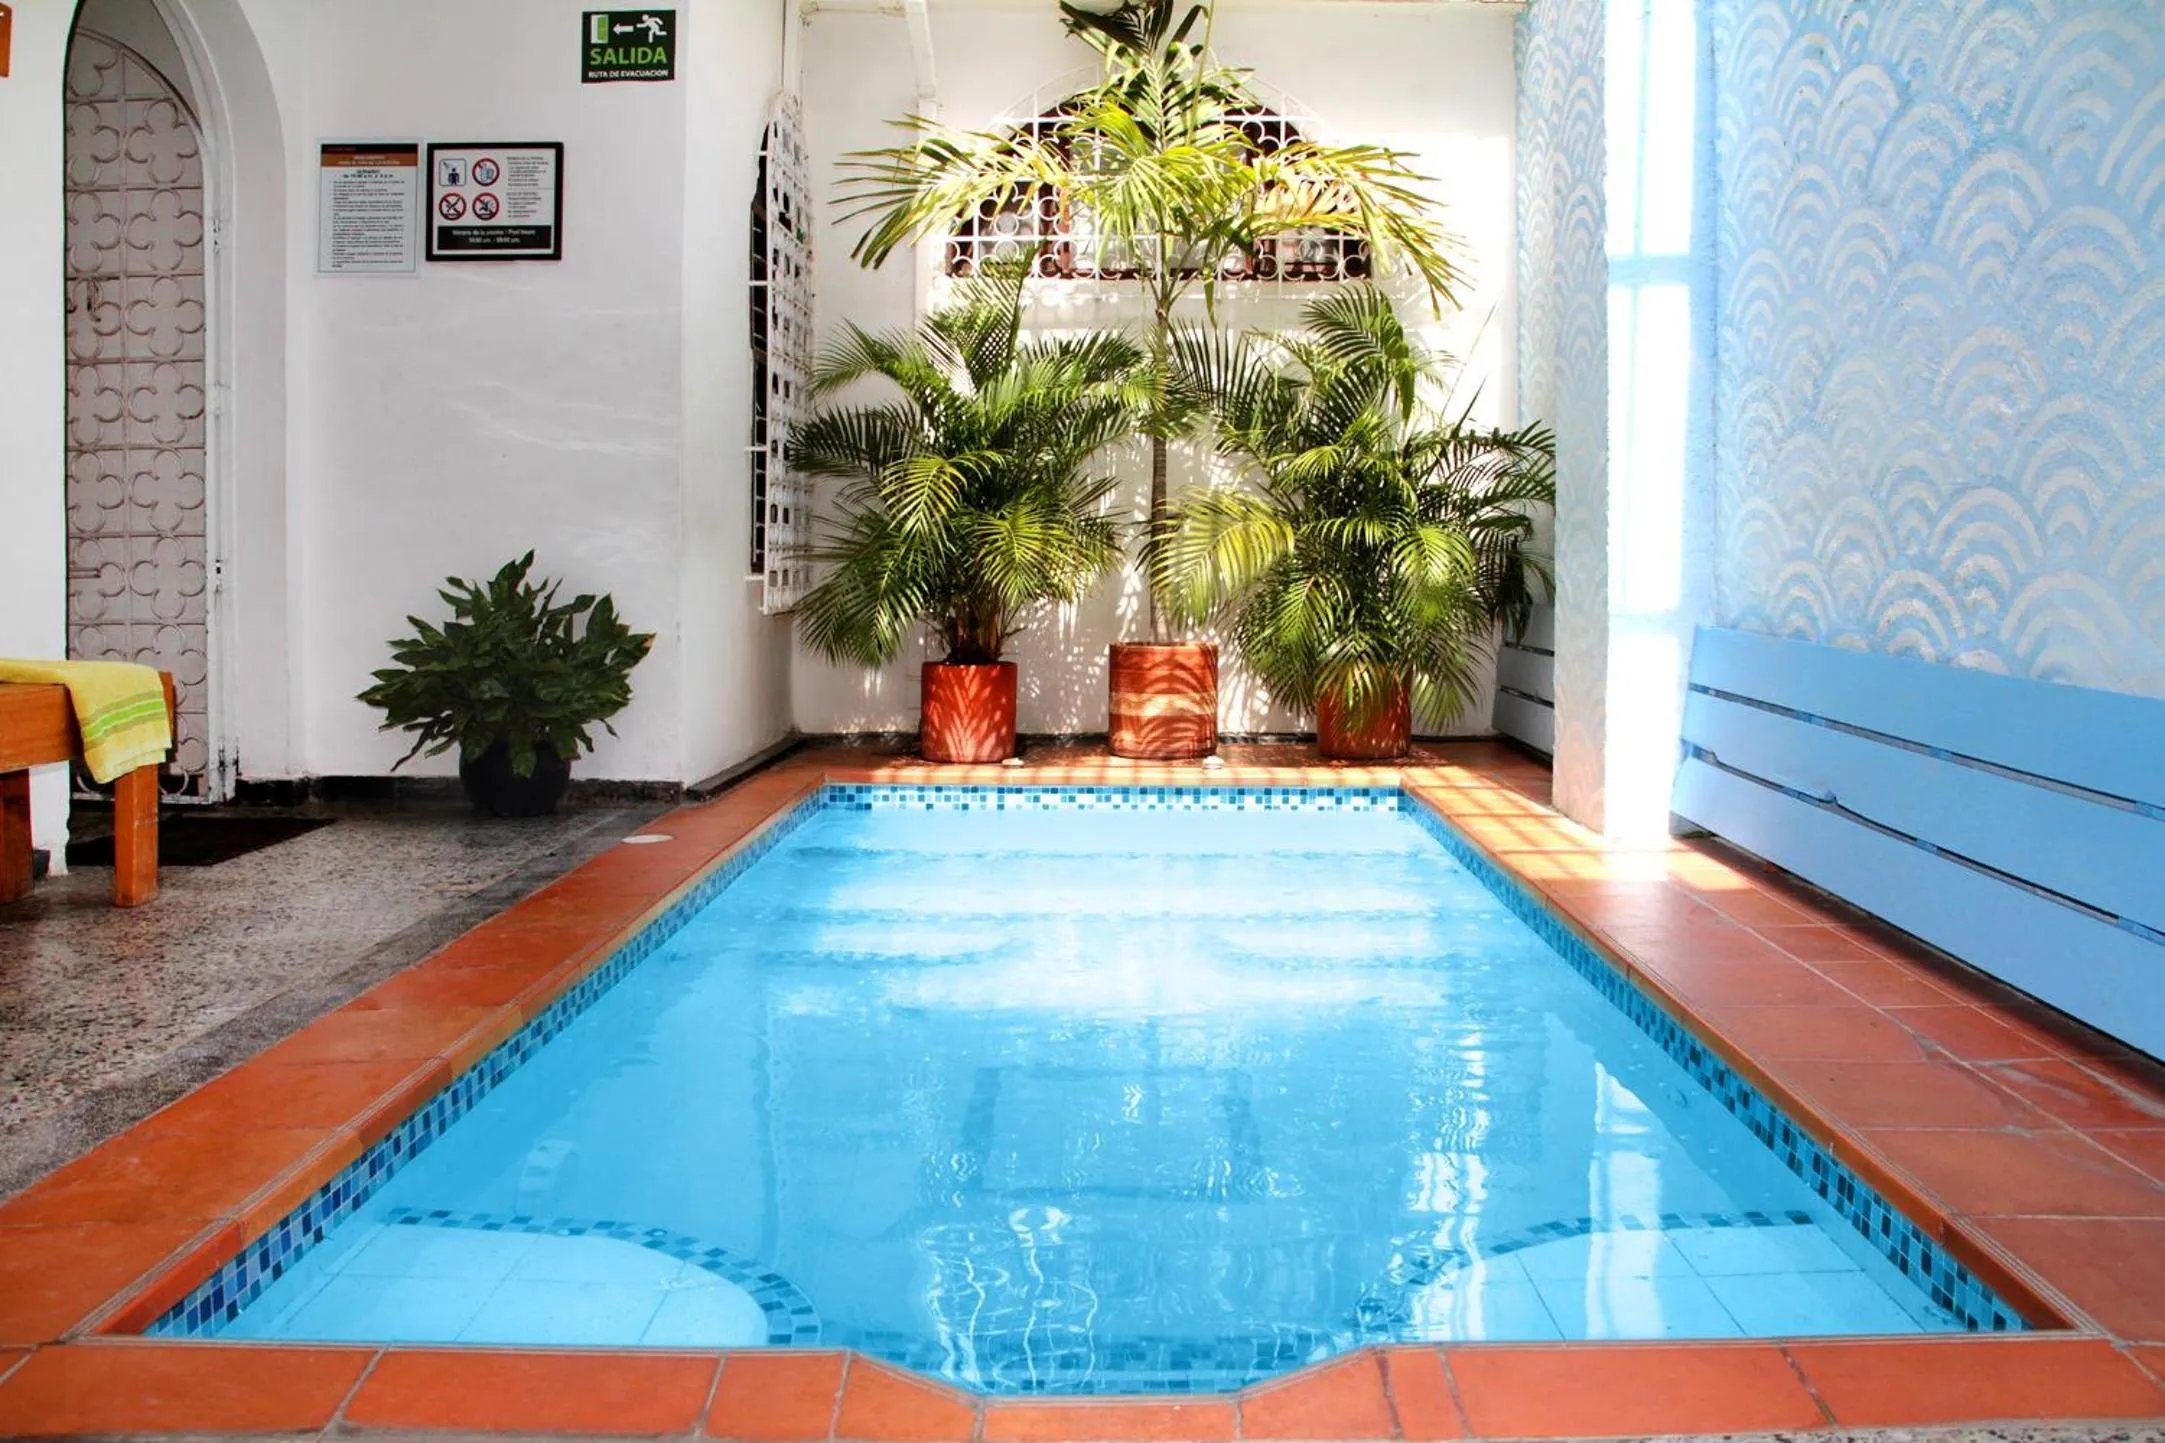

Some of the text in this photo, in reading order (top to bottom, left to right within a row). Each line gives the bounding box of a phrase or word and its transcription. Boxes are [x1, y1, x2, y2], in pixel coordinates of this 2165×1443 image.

[590, 46, 668, 65] SALIDA
[588, 70, 608, 78] RUTA
[609, 70, 619, 78] DE
